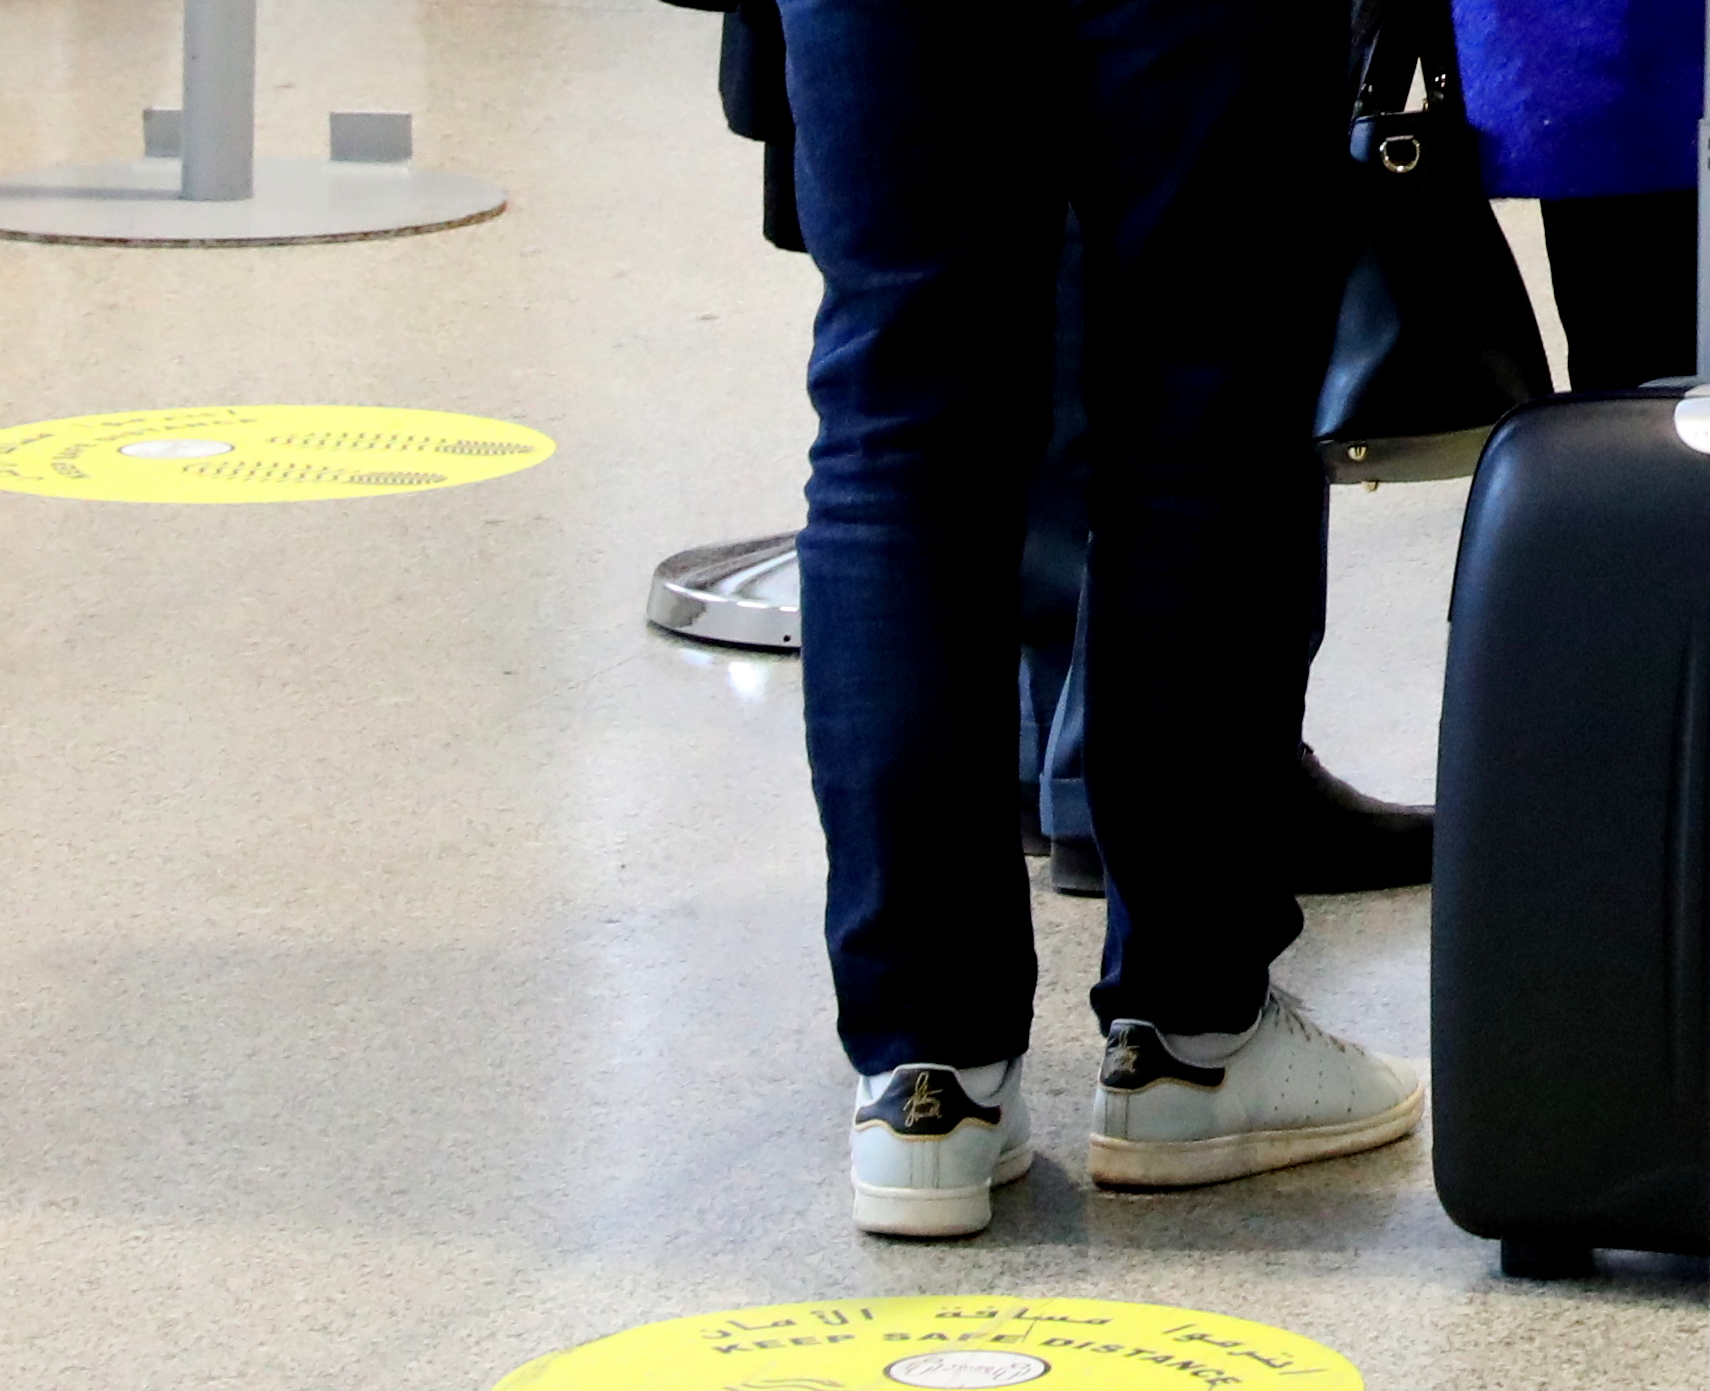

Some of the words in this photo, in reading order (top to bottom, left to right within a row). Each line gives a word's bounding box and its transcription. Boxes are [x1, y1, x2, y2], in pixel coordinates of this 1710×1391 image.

[712, 1334, 855, 1354] KEEP
[883, 1332, 1026, 1344] SAFE
[1040, 1337, 1243, 1387] DISTANCE
